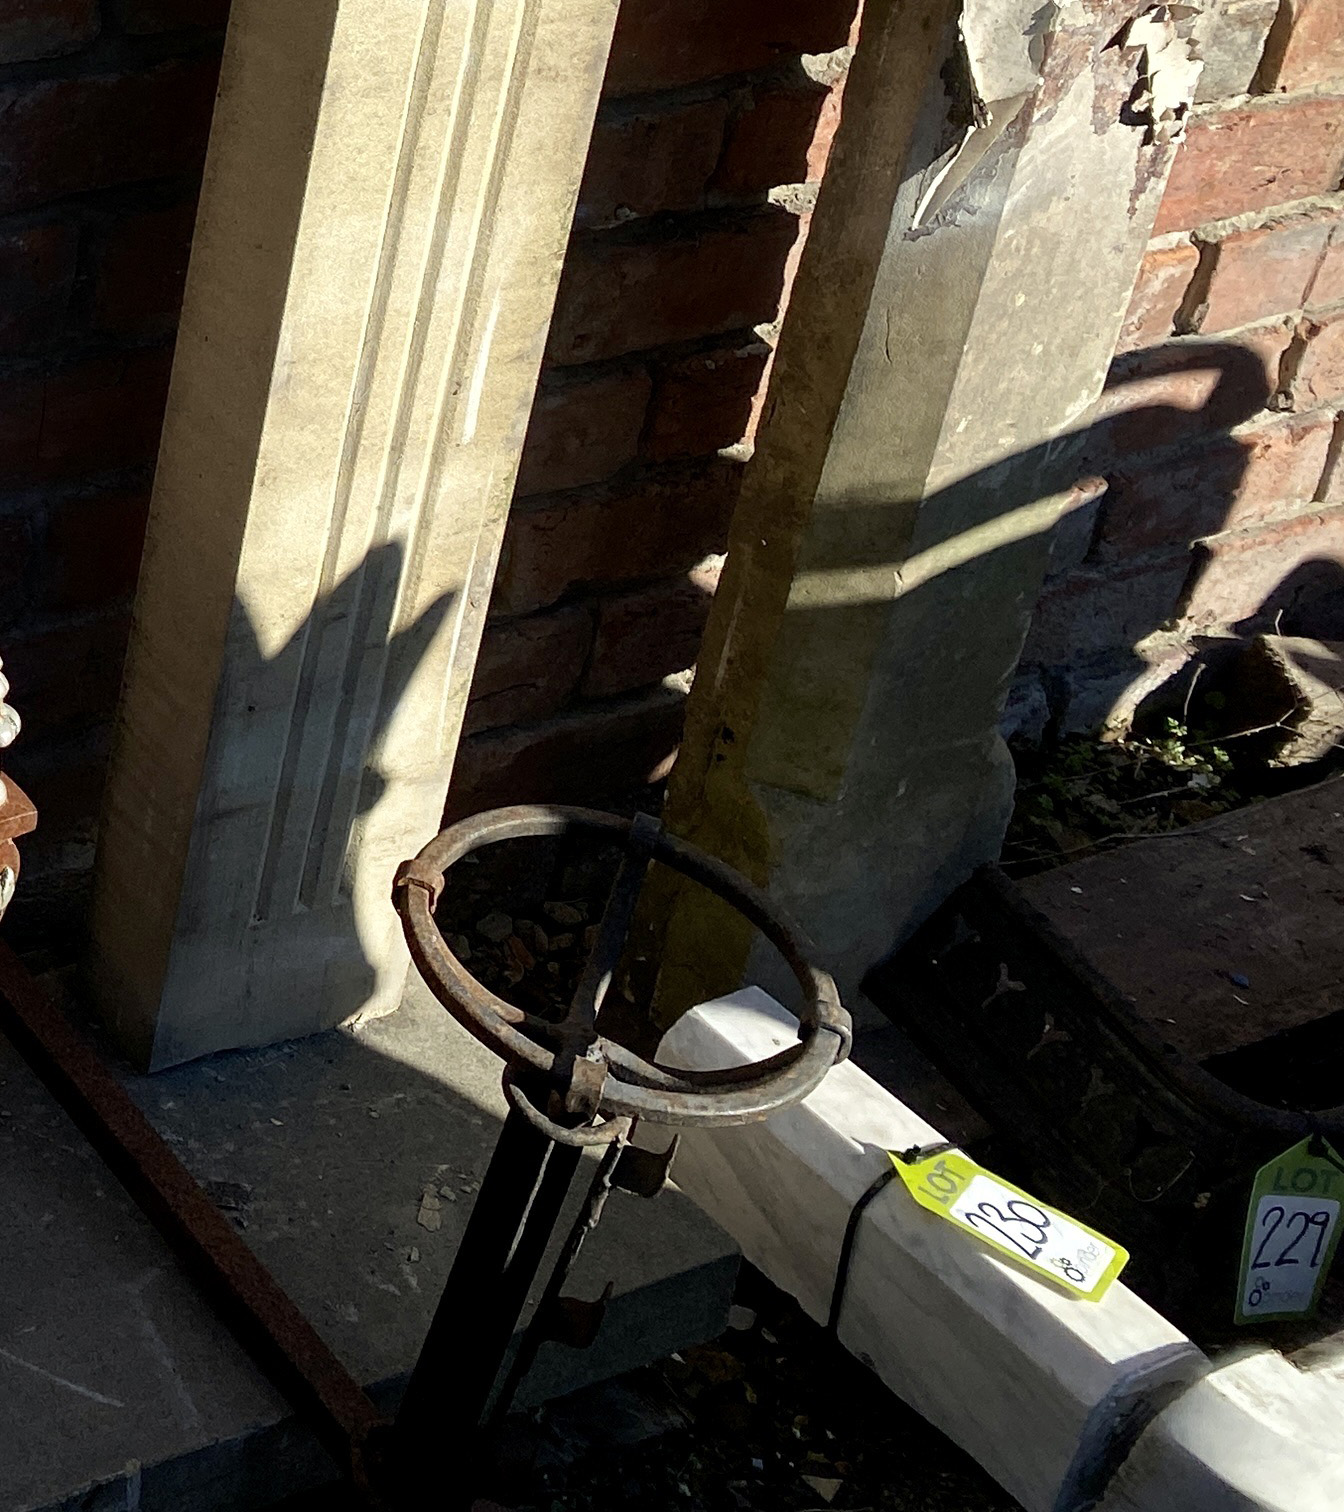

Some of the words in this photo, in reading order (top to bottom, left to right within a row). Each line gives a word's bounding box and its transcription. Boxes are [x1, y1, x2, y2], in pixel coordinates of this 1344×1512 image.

[917, 1159, 967, 1206] LOT
[1272, 1166, 1339, 1195] LOT
[965, 1199, 1051, 1260] 230
[1250, 1205, 1331, 1270] 229
